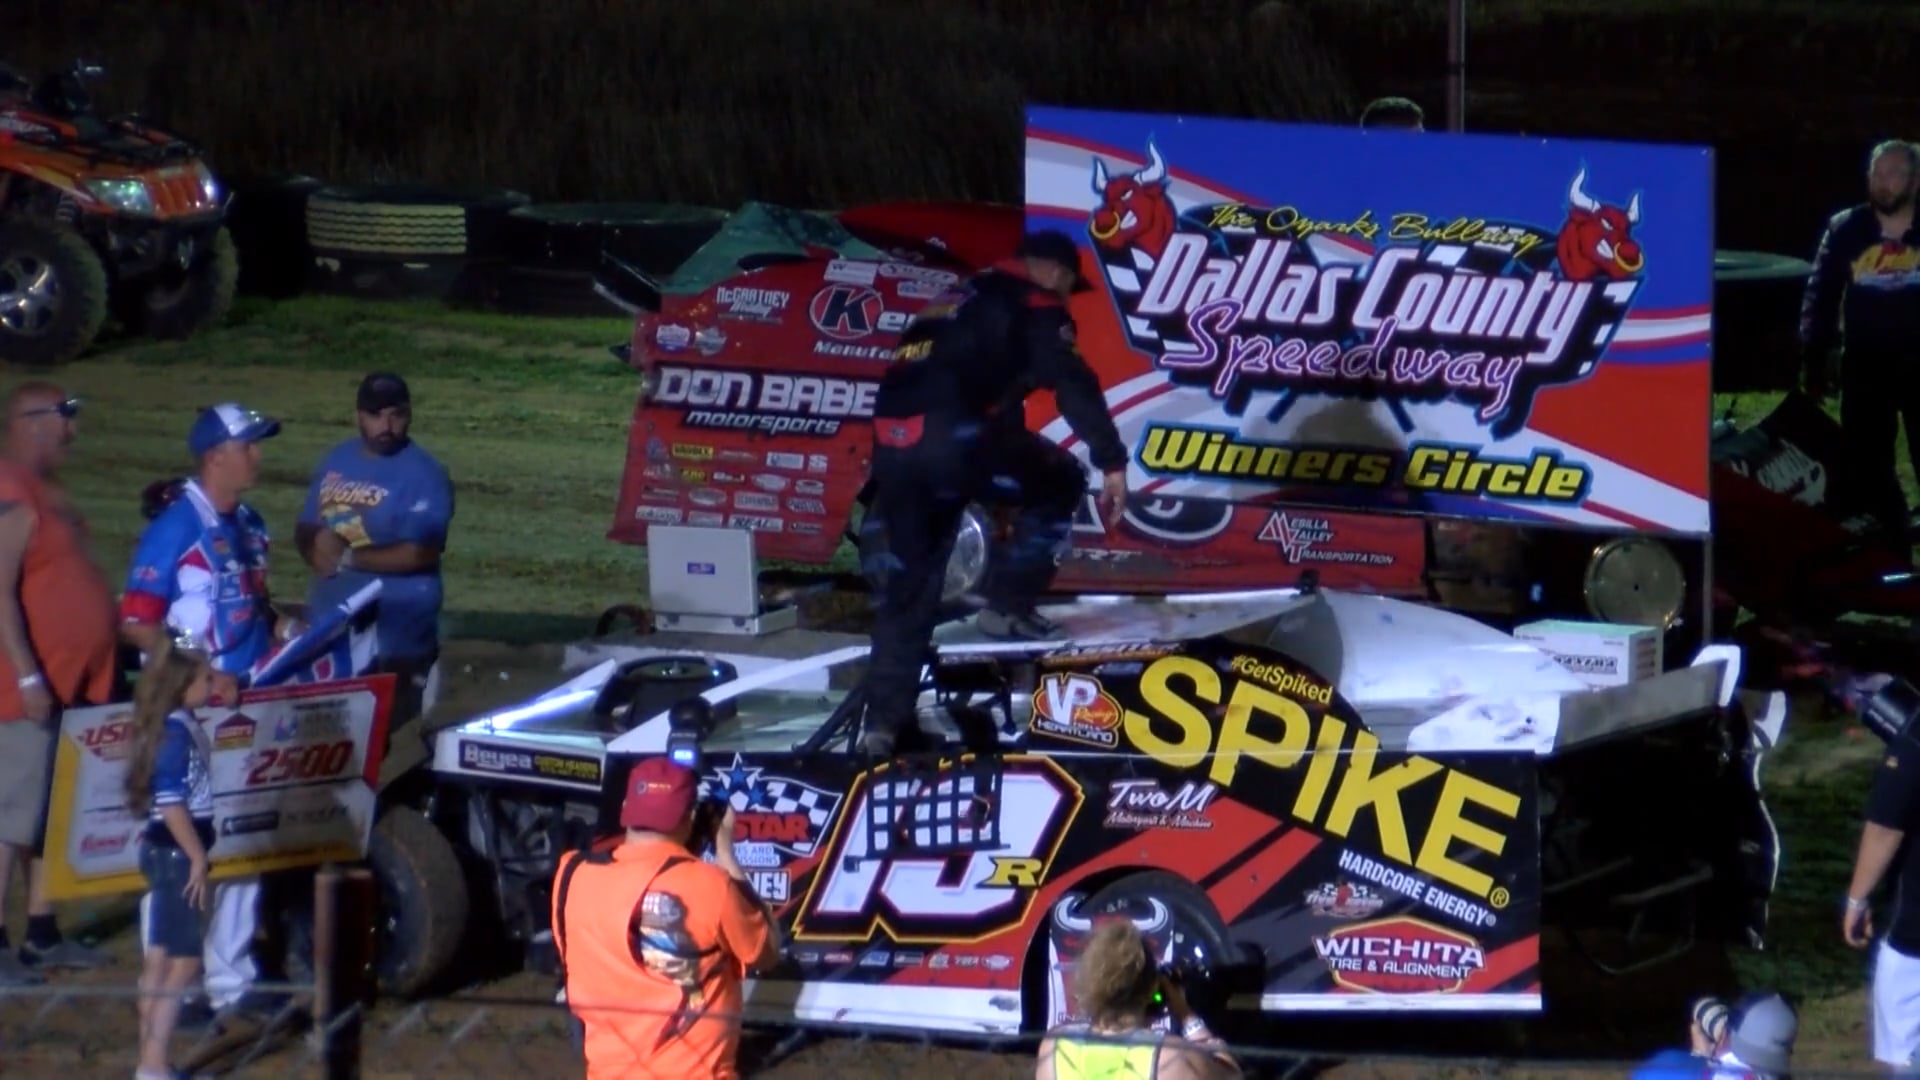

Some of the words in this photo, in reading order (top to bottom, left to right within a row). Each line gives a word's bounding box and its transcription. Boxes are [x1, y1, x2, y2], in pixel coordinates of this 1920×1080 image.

[1207, 203, 1256, 229] The
[1266, 206, 1381, 238] Ozarks
[1388, 213, 1542, 259] Bullring
[1136, 232, 1354, 325] Dallas
[1351, 247, 1593, 364] County
[1160, 297, 1522, 418] Speedway
[654, 366, 753, 408] DON
[686, 410, 842, 434] motorsports
[1141, 426, 1388, 484] Winners
[1404, 446, 1586, 499] Circle
[1046, 677, 1097, 725] VP
[1231, 654, 1334, 706] #GetSpiked
[1110, 780, 1169, 808] Two
[1164, 783, 1215, 812] M
[1124, 655, 1522, 899] SPIKE
[1338, 849, 1426, 900] HARDCORE
[1424, 885, 1488, 927] ENERGY
[1315, 936, 1484, 968] WICHITA
[1329, 956, 1363, 971] TIRE
[1367, 959, 1377, 971] &
[1383, 960, 1472, 979] ALIGNMENT
